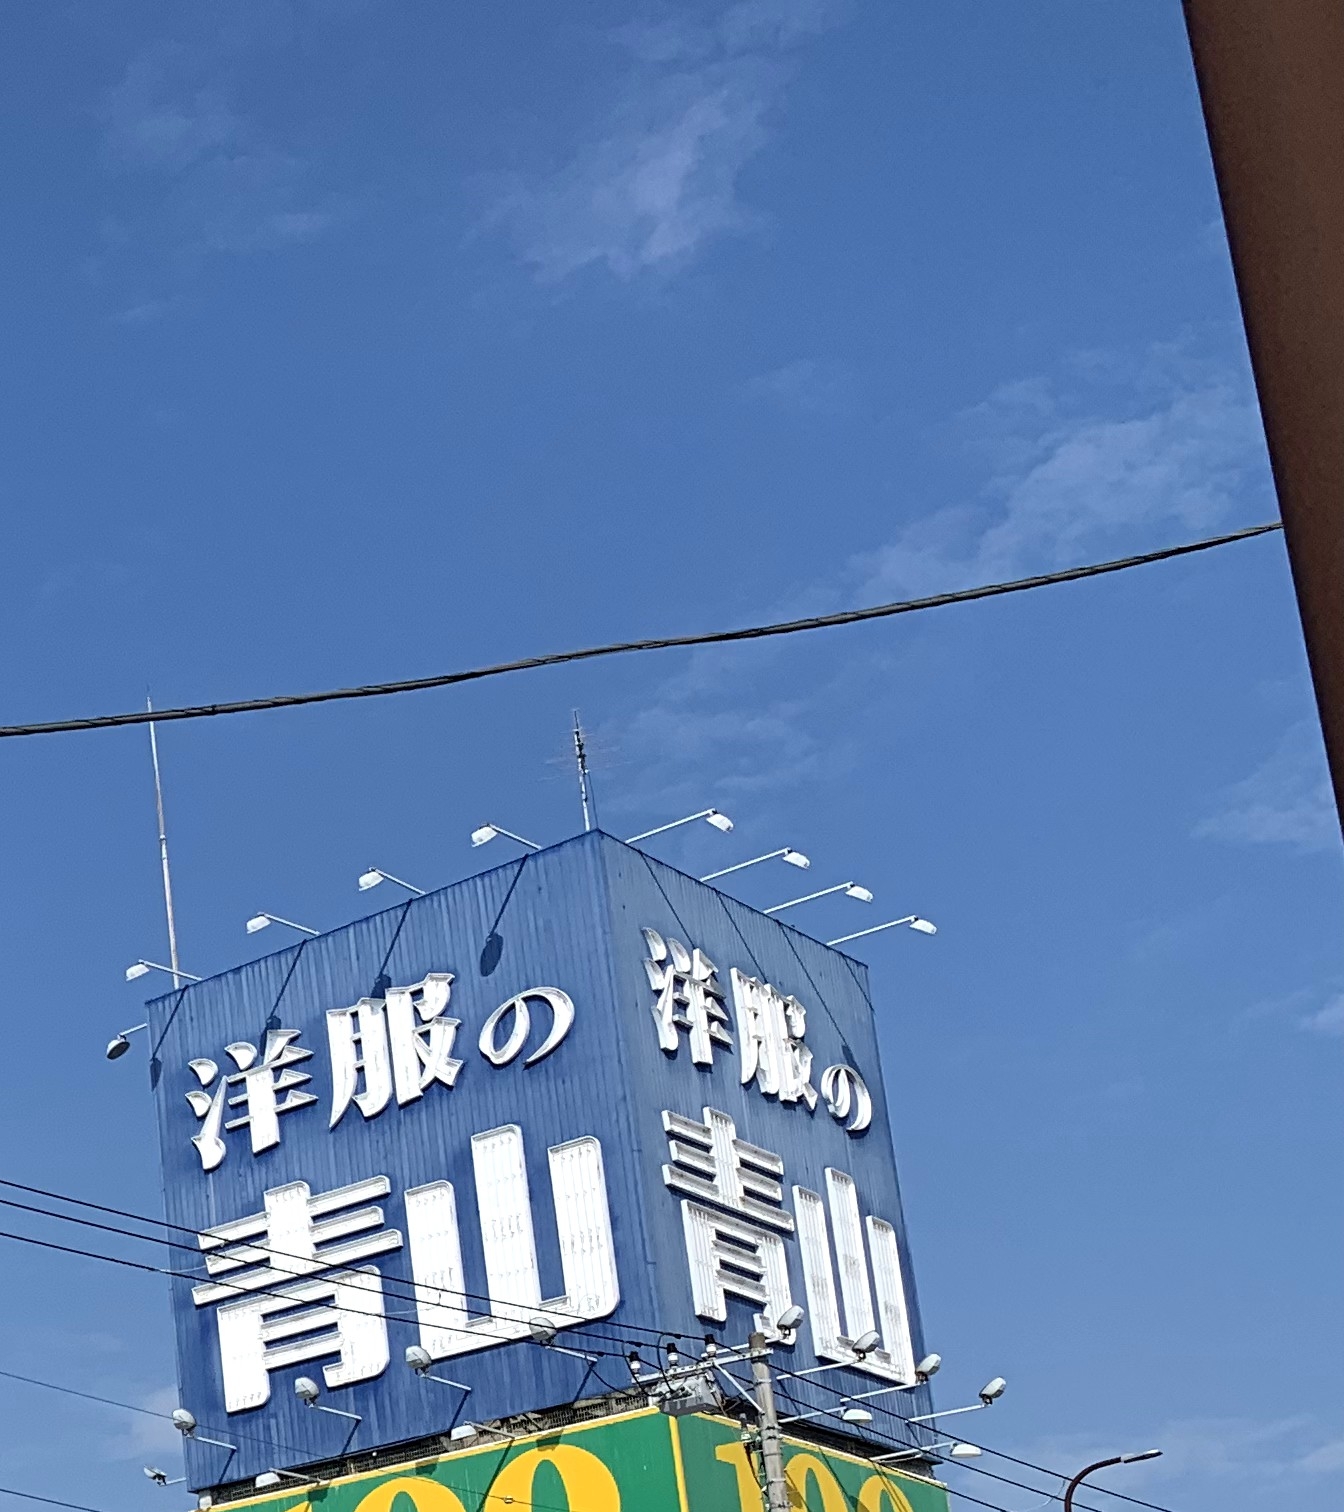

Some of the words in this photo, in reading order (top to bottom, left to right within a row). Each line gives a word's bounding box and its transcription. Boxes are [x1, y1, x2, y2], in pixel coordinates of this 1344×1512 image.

[184, 972, 576, 1173] 洋服の
[641, 925, 874, 1134] 洋服の
[191, 1123, 620, 1413] 青山
[662, 1106, 916, 1386] 青山
